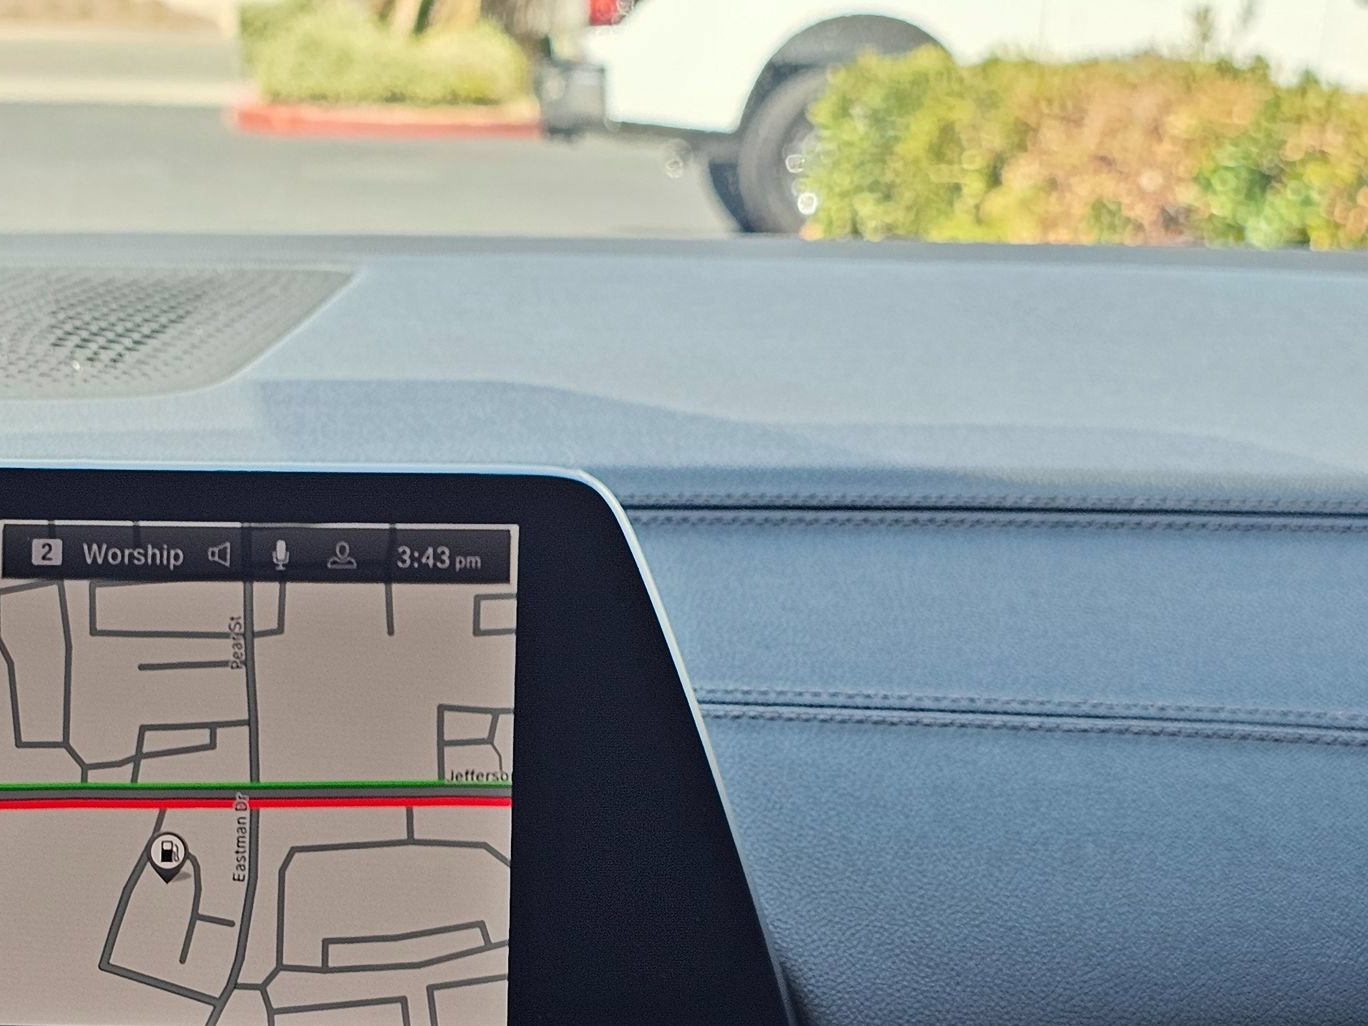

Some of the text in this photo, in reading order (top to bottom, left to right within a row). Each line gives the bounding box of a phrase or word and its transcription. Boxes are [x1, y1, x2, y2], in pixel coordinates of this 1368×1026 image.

[40, 541, 184, 570] 2 Worship
[396, 545, 483, 573] 3:43 pm
[229, 616, 242, 632] St
[233, 792, 250, 883] Eastman Dr
